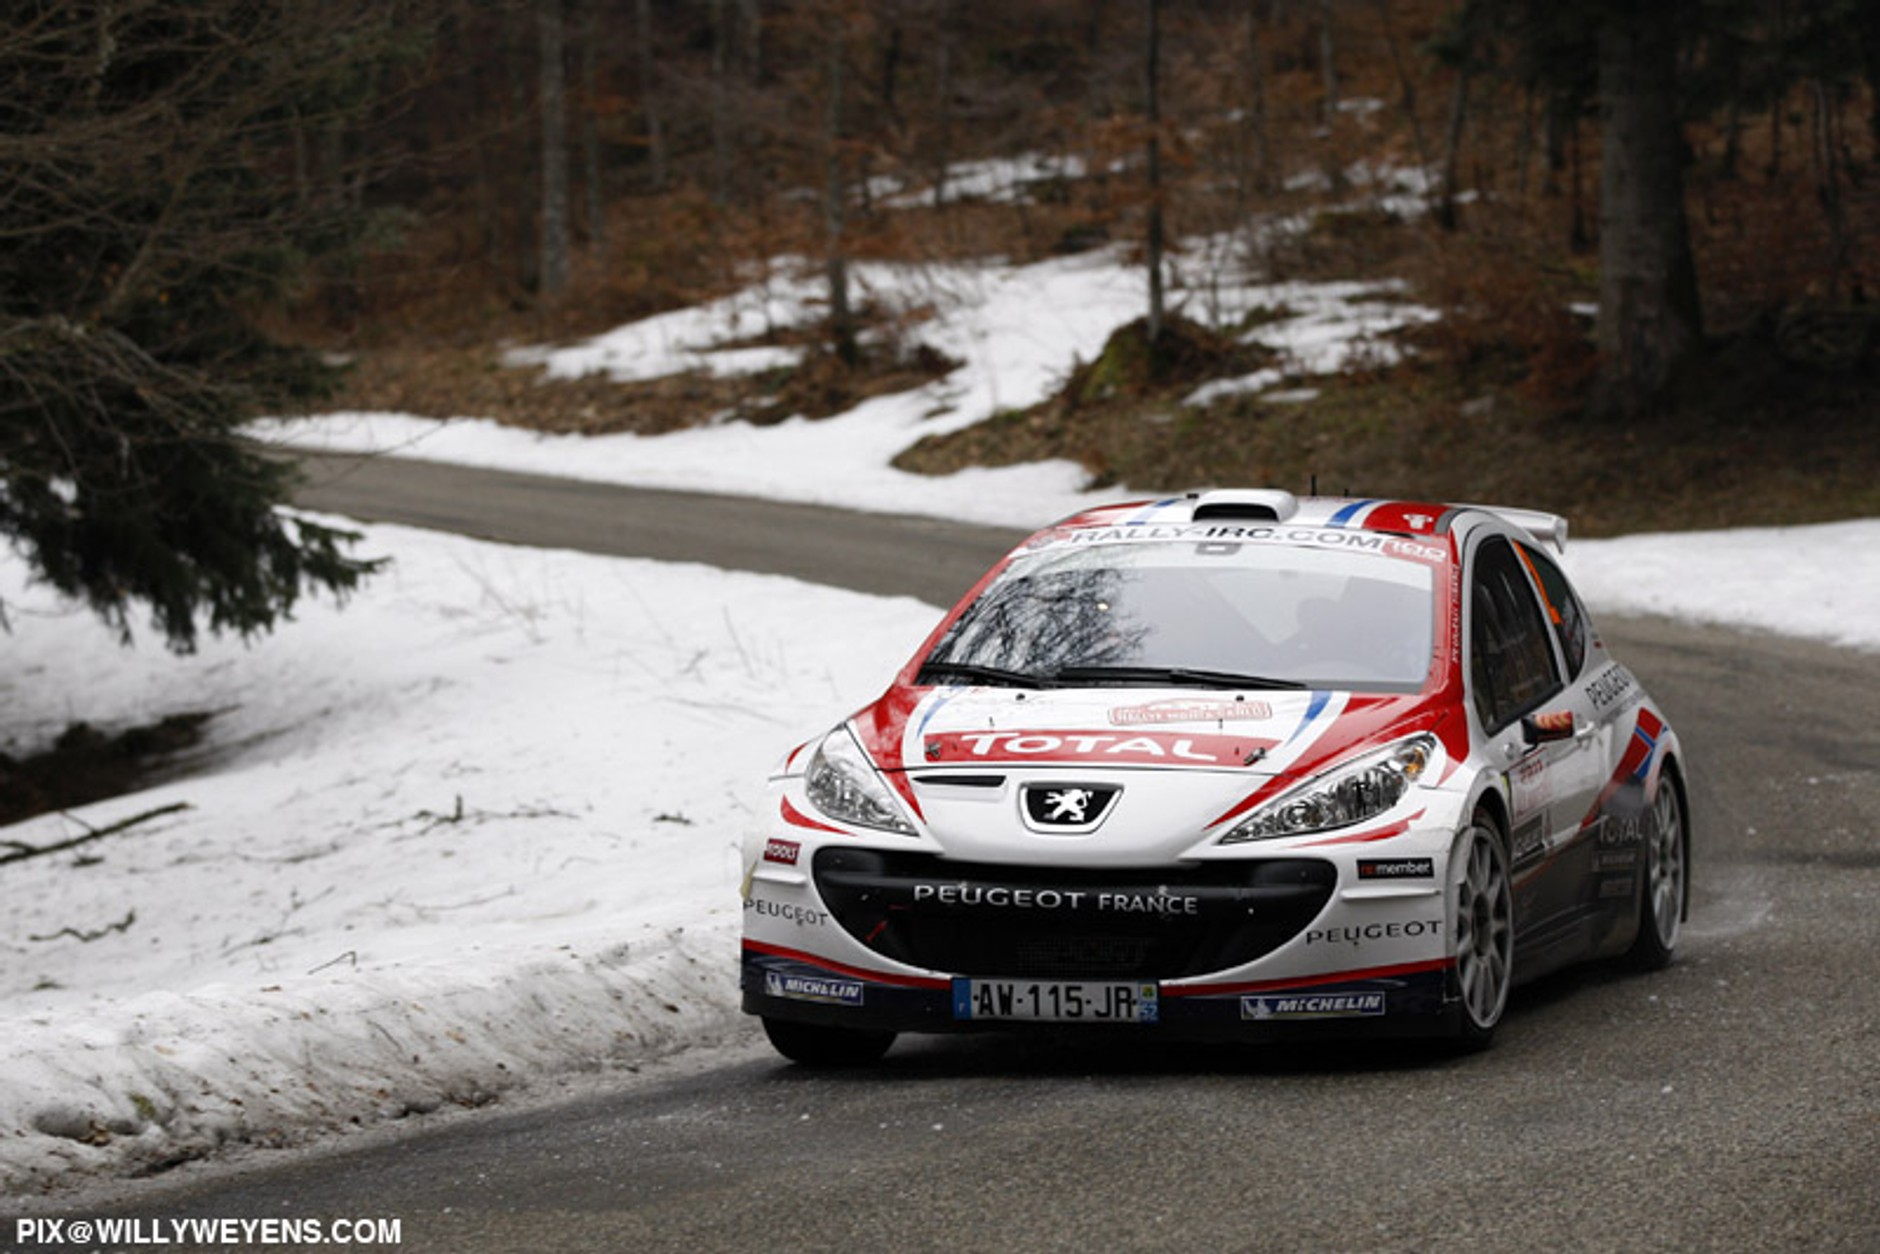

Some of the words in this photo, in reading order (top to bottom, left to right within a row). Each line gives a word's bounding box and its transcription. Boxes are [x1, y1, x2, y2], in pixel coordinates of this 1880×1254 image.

[1072, 527, 1382, 549] RALLY-IRC.COM
[960, 732, 1217, 762] TOTAL
[743, 898, 829, 926] PEUGEOT
[913, 884, 1087, 910] PEUGEOT
[1098, 893, 1198, 915] FRANCE
[1305, 920, 1442, 946] PEUGEOT
[785, 978, 860, 998] MICHELIN
[1275, 995, 1382, 1012] MICHELIN
